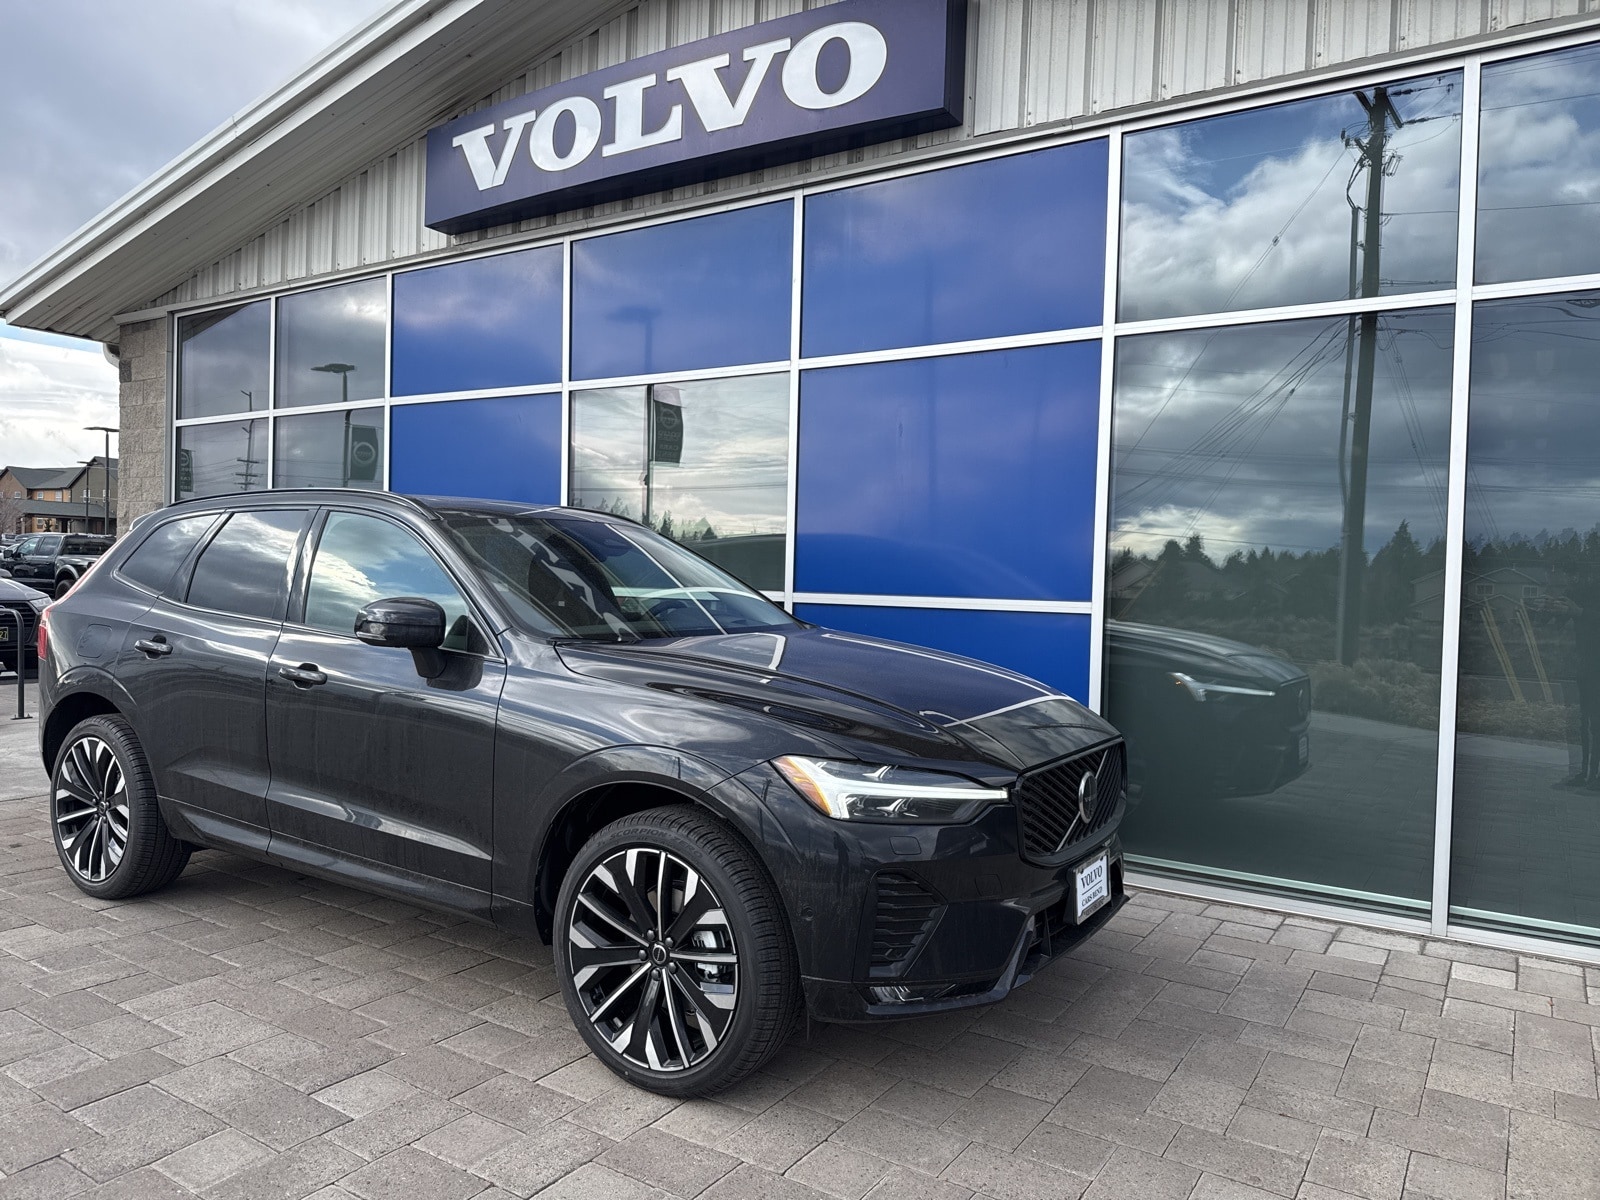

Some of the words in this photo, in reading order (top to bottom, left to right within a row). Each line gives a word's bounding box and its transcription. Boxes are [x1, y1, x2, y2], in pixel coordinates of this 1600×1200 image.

[452, 21, 888, 192] VOLVO
[610, 828, 667, 839] SCORPION
[1081, 865, 1103, 889] VOLVO
[1081, 893, 1093, 907] CARS
